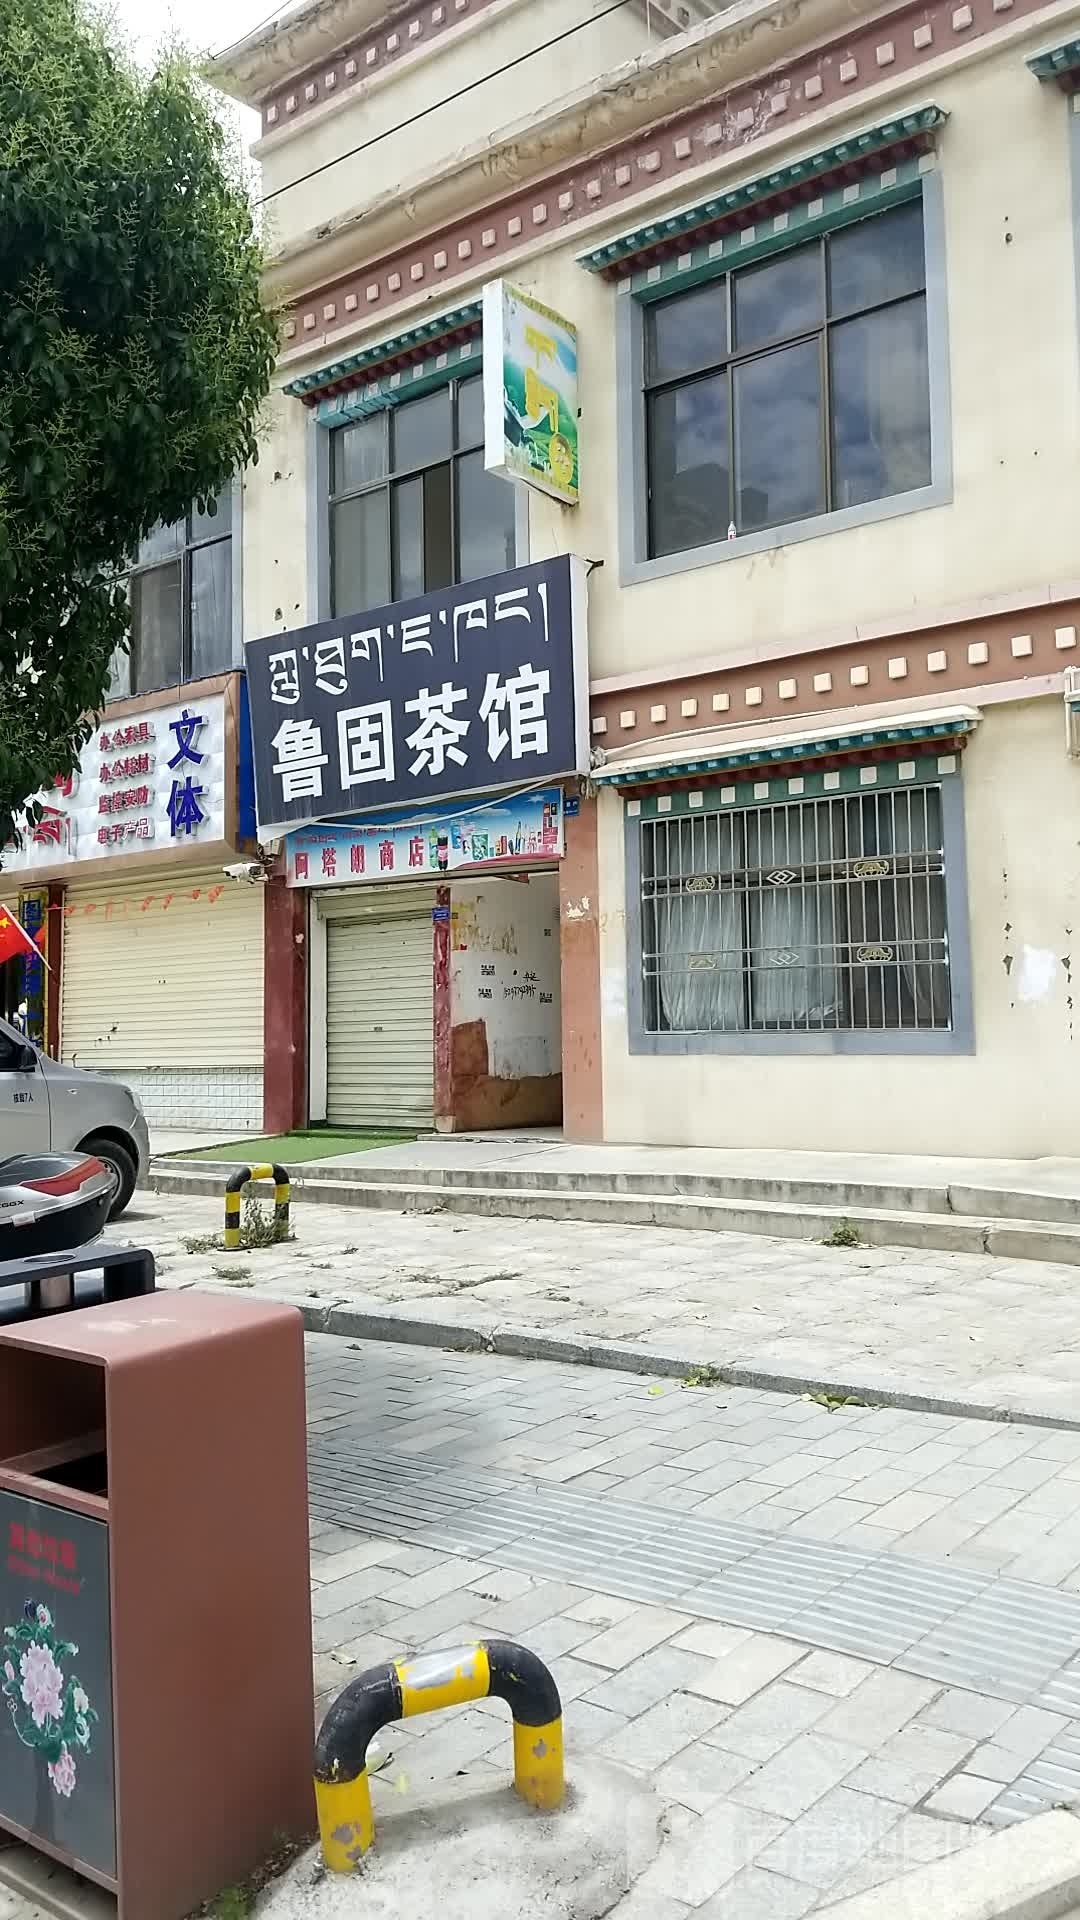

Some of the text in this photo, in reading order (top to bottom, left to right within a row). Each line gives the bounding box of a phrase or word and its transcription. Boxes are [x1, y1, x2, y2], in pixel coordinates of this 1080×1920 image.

[100, 721, 151, 751] 办公家具
[270, 663, 551, 803] 鲁固茶馆
[168, 709, 207, 837] 文体
[97, 817, 150, 844] 电子产品
